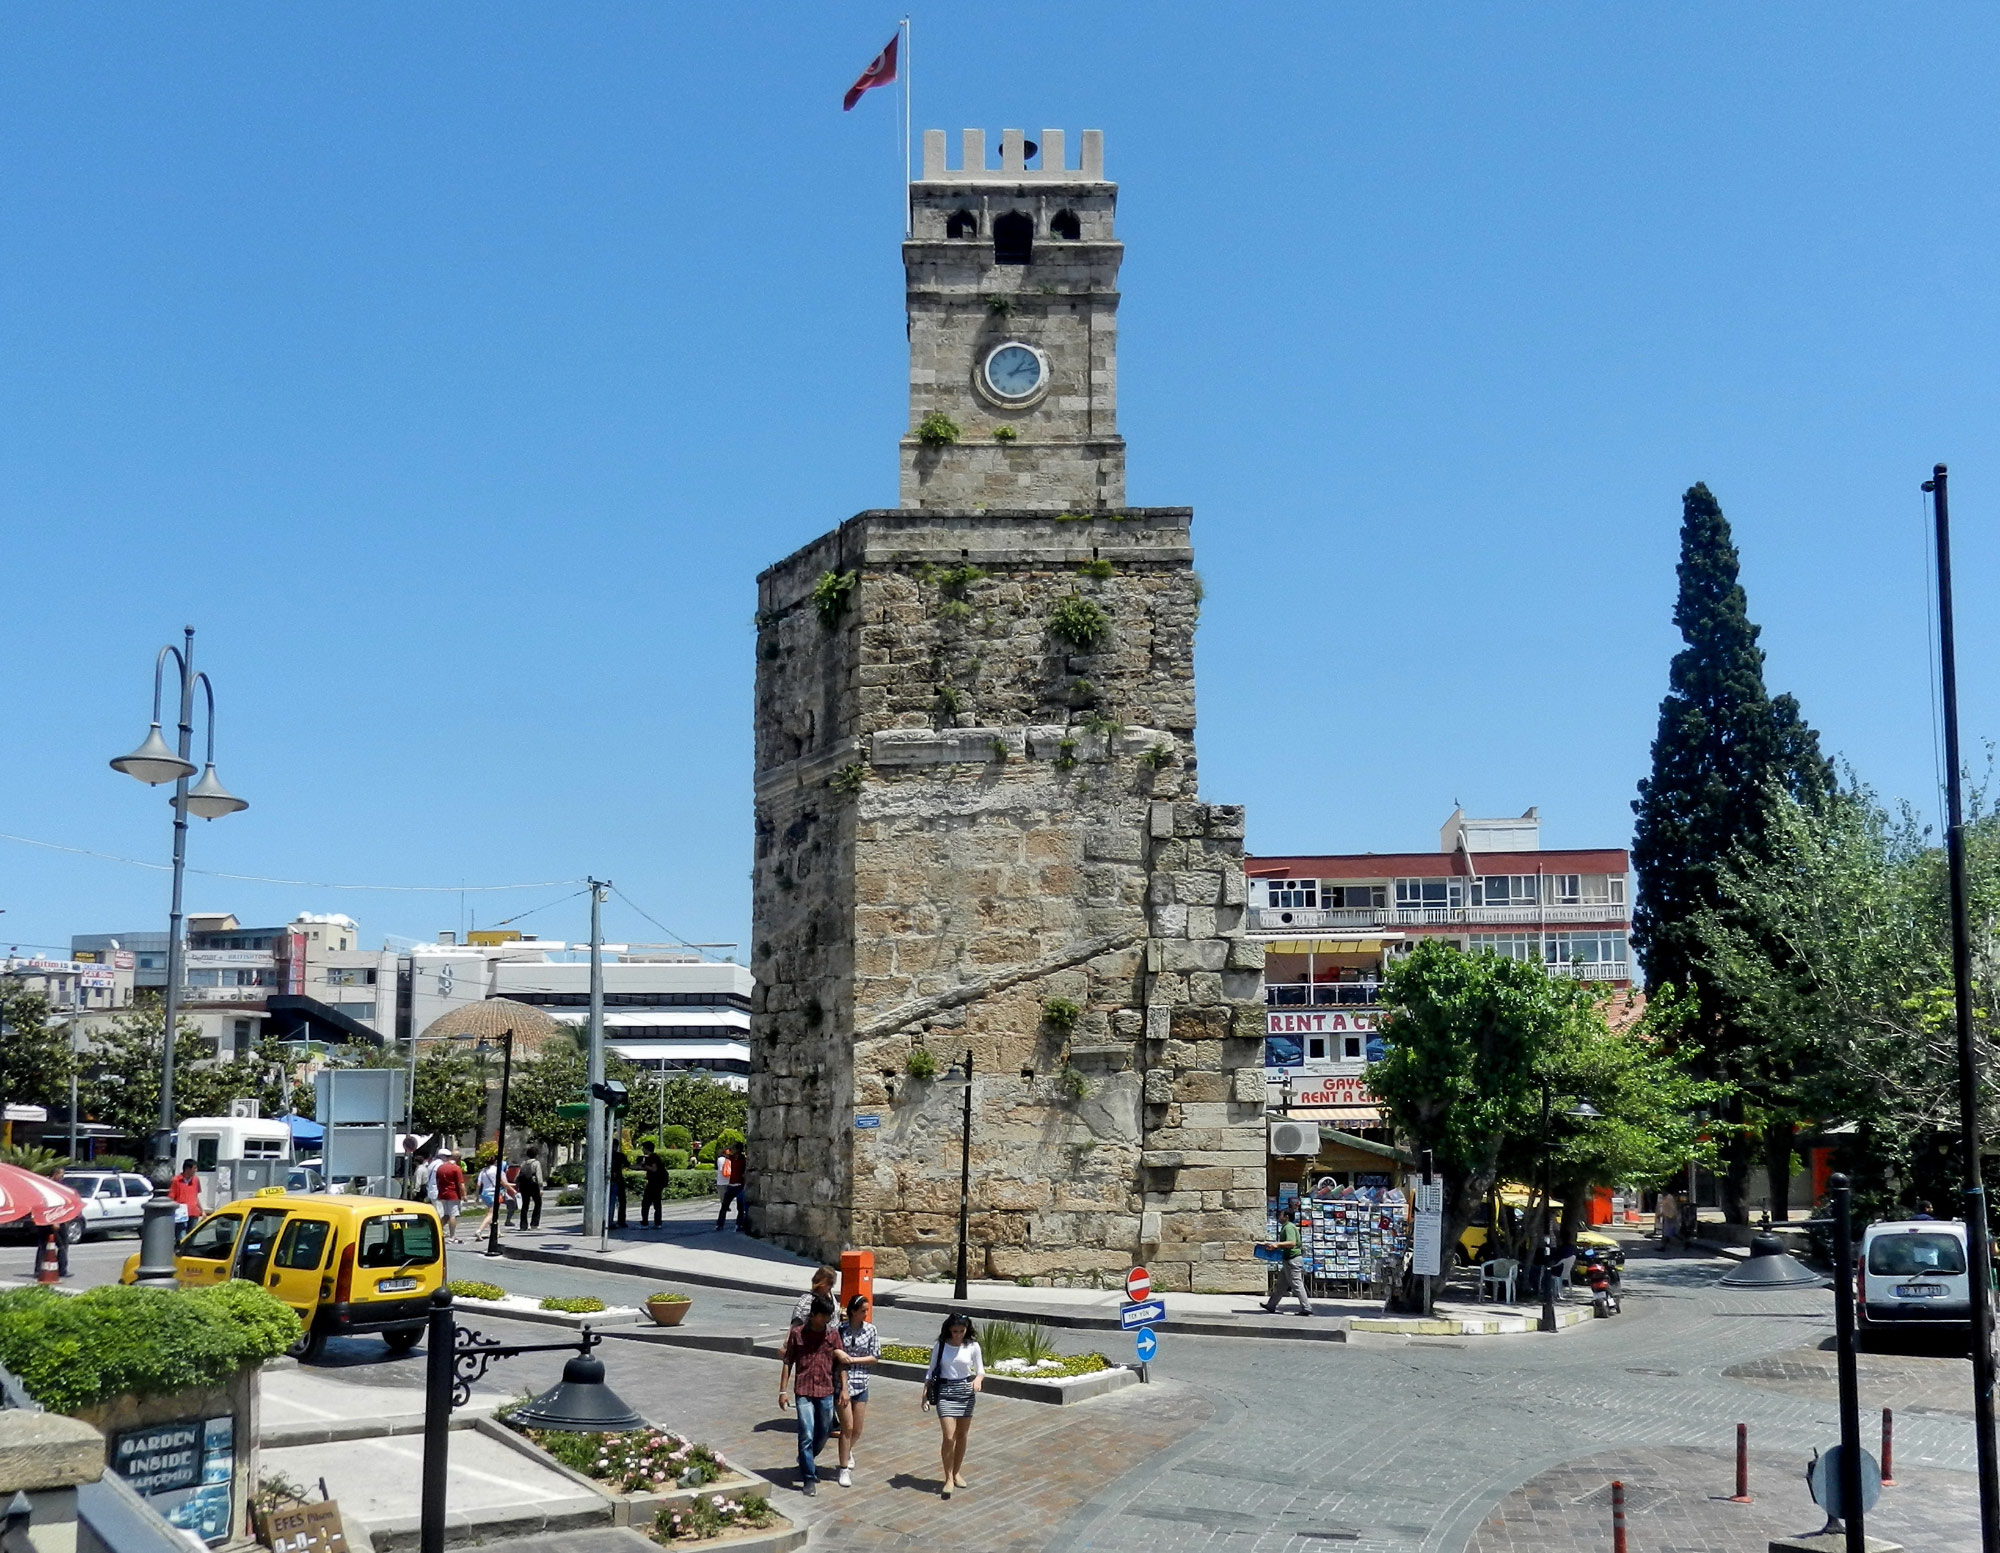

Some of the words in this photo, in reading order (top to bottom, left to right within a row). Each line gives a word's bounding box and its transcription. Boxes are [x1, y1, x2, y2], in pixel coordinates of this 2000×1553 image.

[1270, 1015, 1326, 1031] RENT
[1333, 1014, 1346, 1030] A
[1323, 1078, 1363, 1090] GAYE
[1301, 1091, 1338, 1103] RENT
[1343, 1091, 1353, 1103] A
[121, 1430, 196, 1454] GARDEN
[129, 1451, 192, 1475] INSIDE
[274, 1512, 304, 1532] EFES
